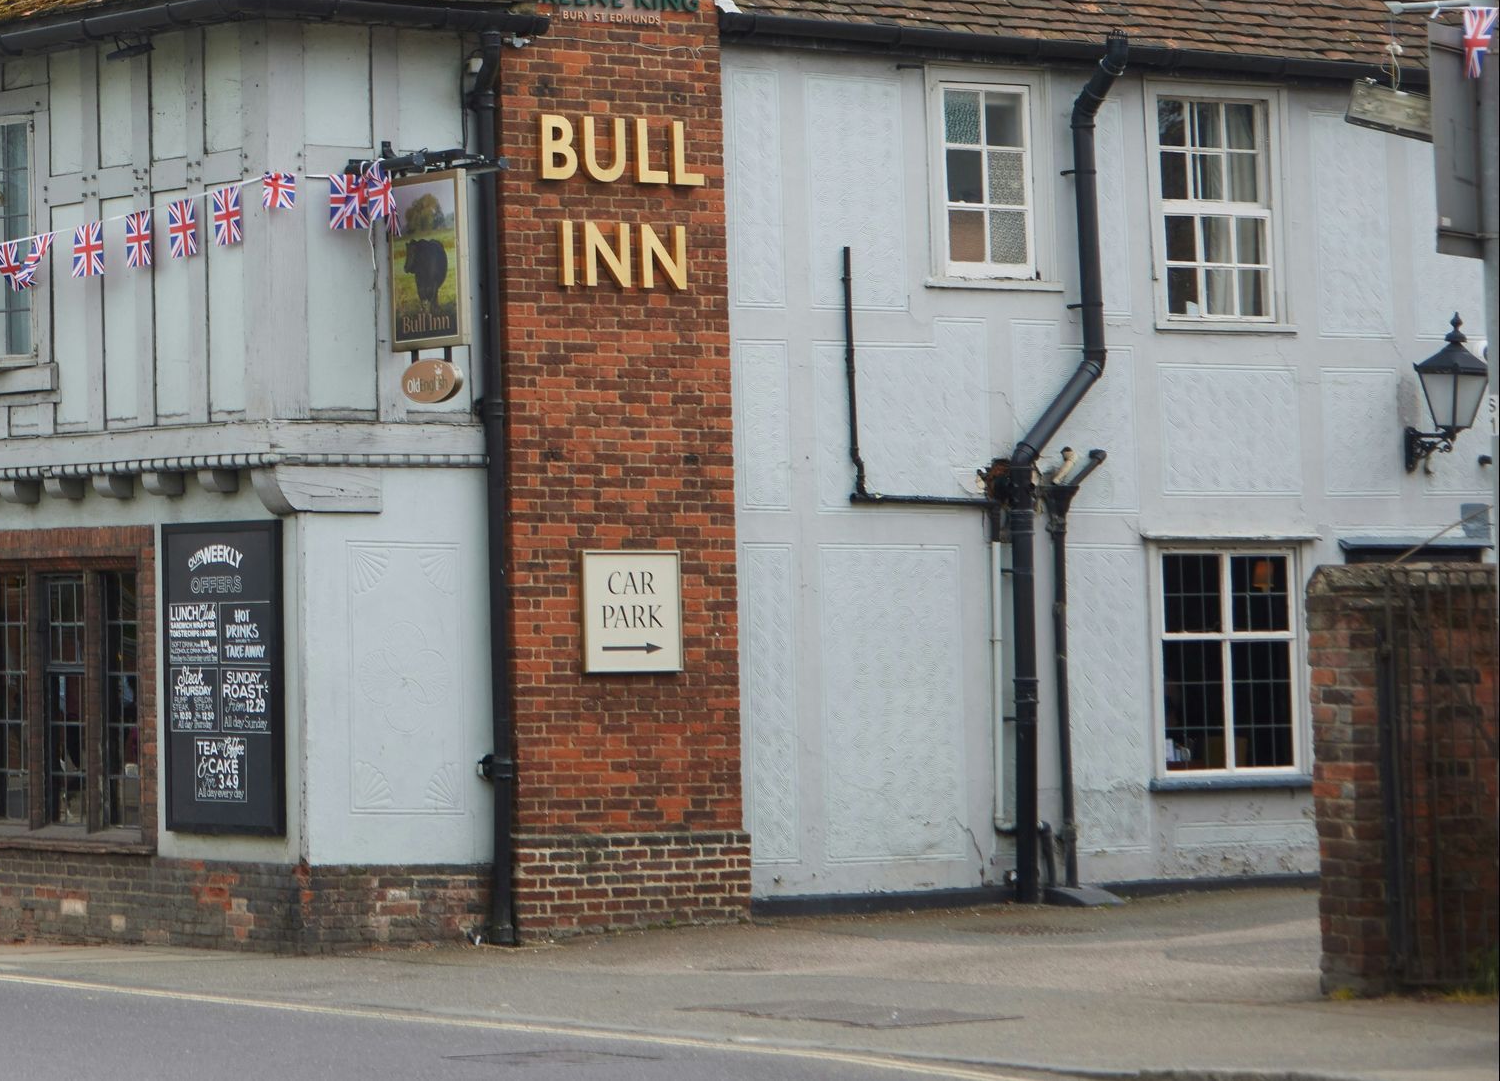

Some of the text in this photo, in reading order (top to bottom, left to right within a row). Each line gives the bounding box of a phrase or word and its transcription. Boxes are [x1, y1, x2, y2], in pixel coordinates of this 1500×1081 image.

[563, 10, 661, 25] BURY ST EDMUNDS
[538, 114, 705, 187] BULL
[558, 220, 688, 291] INN
[403, 312, 450, 334] Bull Inn
[188, 545, 243, 569] OUR WEEKLY
[190, 575, 242, 594] OFFERS
[608, 570, 656, 595] CAR
[170, 606, 199, 621] LUNCH
[234, 609, 250, 623] HOT
[602, 605, 664, 629] PARK
[226, 624, 260, 639] DRINKS
[178, 666, 204, 687] Steak
[226, 671, 261, 684] SUNDAY
[175, 685, 212, 696] THURSDAY
[223, 685, 264, 699] ROAST
[246, 698, 265, 713] 12.29
[197, 741, 218, 755] TEA
[208, 758, 238, 774] CAKE
